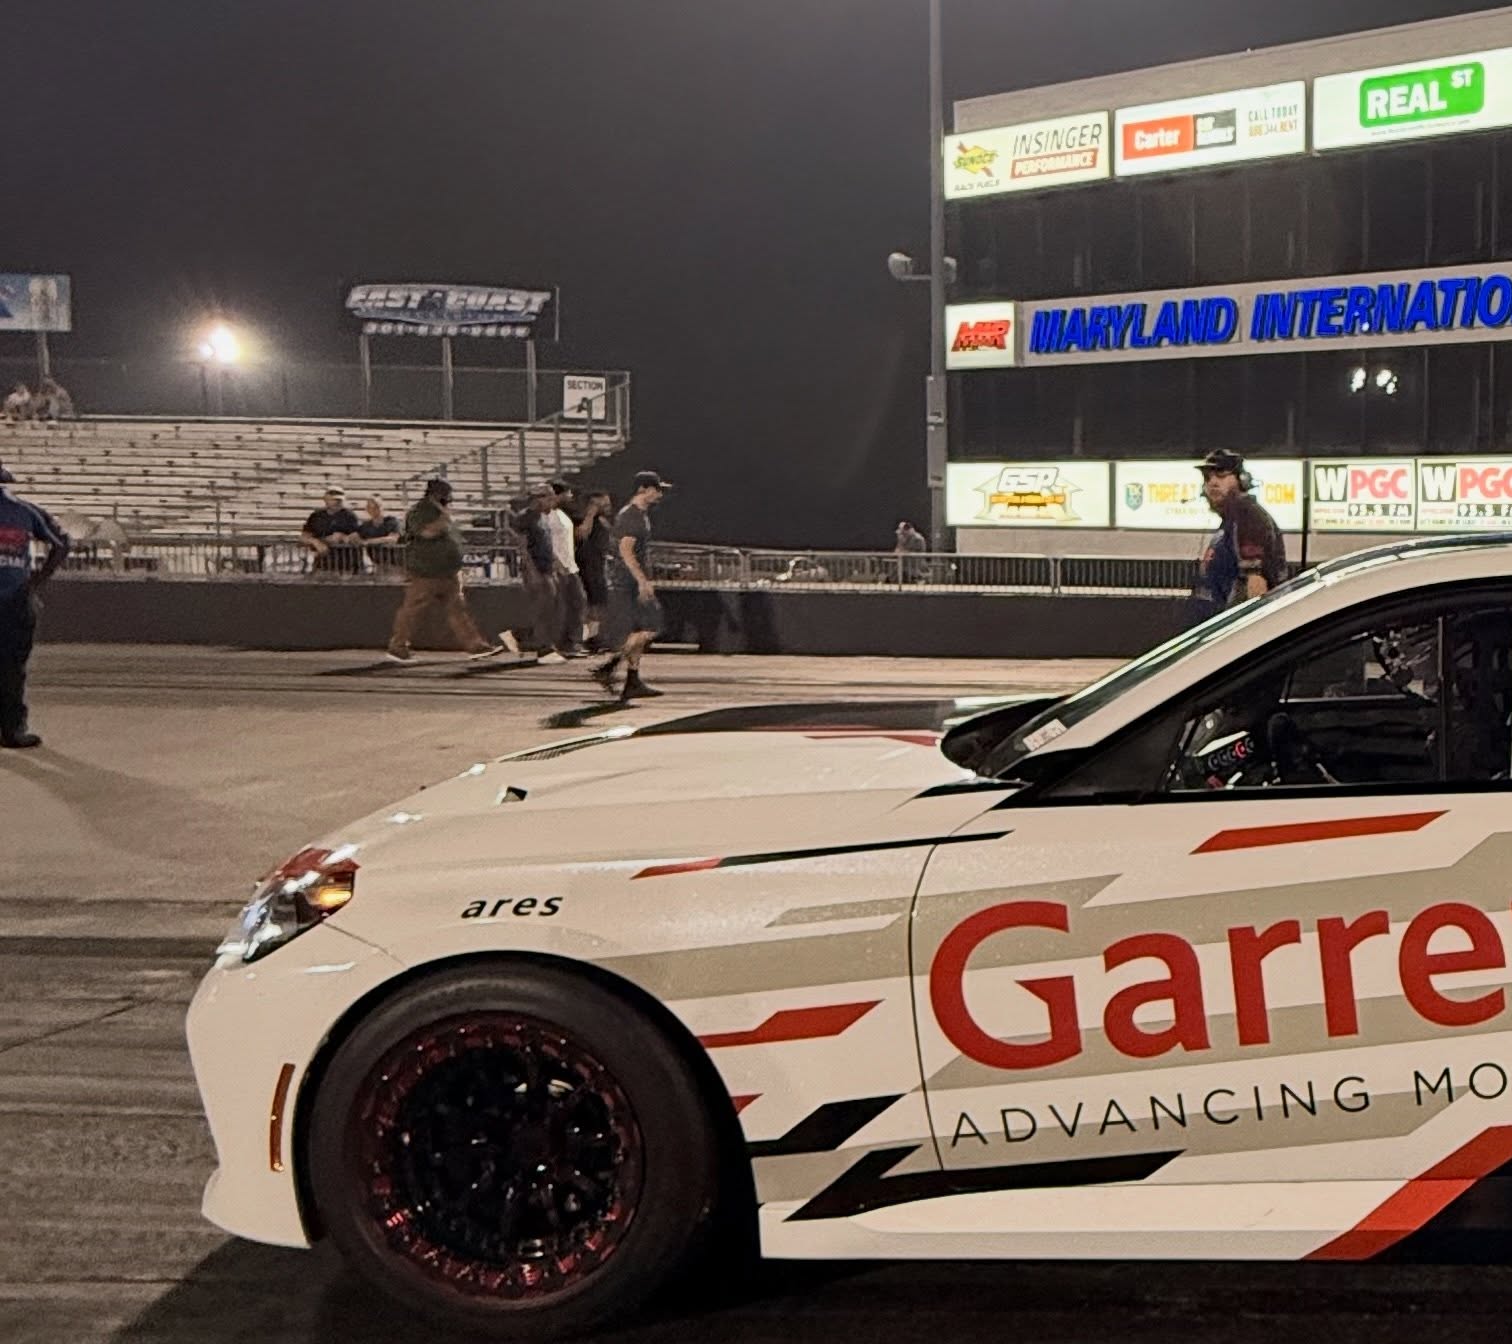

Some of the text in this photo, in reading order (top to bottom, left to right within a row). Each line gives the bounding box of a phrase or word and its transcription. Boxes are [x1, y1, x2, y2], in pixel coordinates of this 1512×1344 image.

[1366, 68, 1475, 120] REAL ST
[1248, 104, 1298, 122] CALL TODAY
[1013, 123, 1102, 156] INSINGER
[1134, 127, 1181, 151] Carter
[1014, 150, 1096, 176] PERFORMANCE
[346, 288, 551, 314] EAST COAST
[1029, 297, 1240, 354] MARYLAND
[567, 379, 604, 391] SECTION
[1314, 466, 1409, 502] WPGC
[460, 896, 564, 919] ares
[951, 1074, 1371, 1148] ADVANCING
